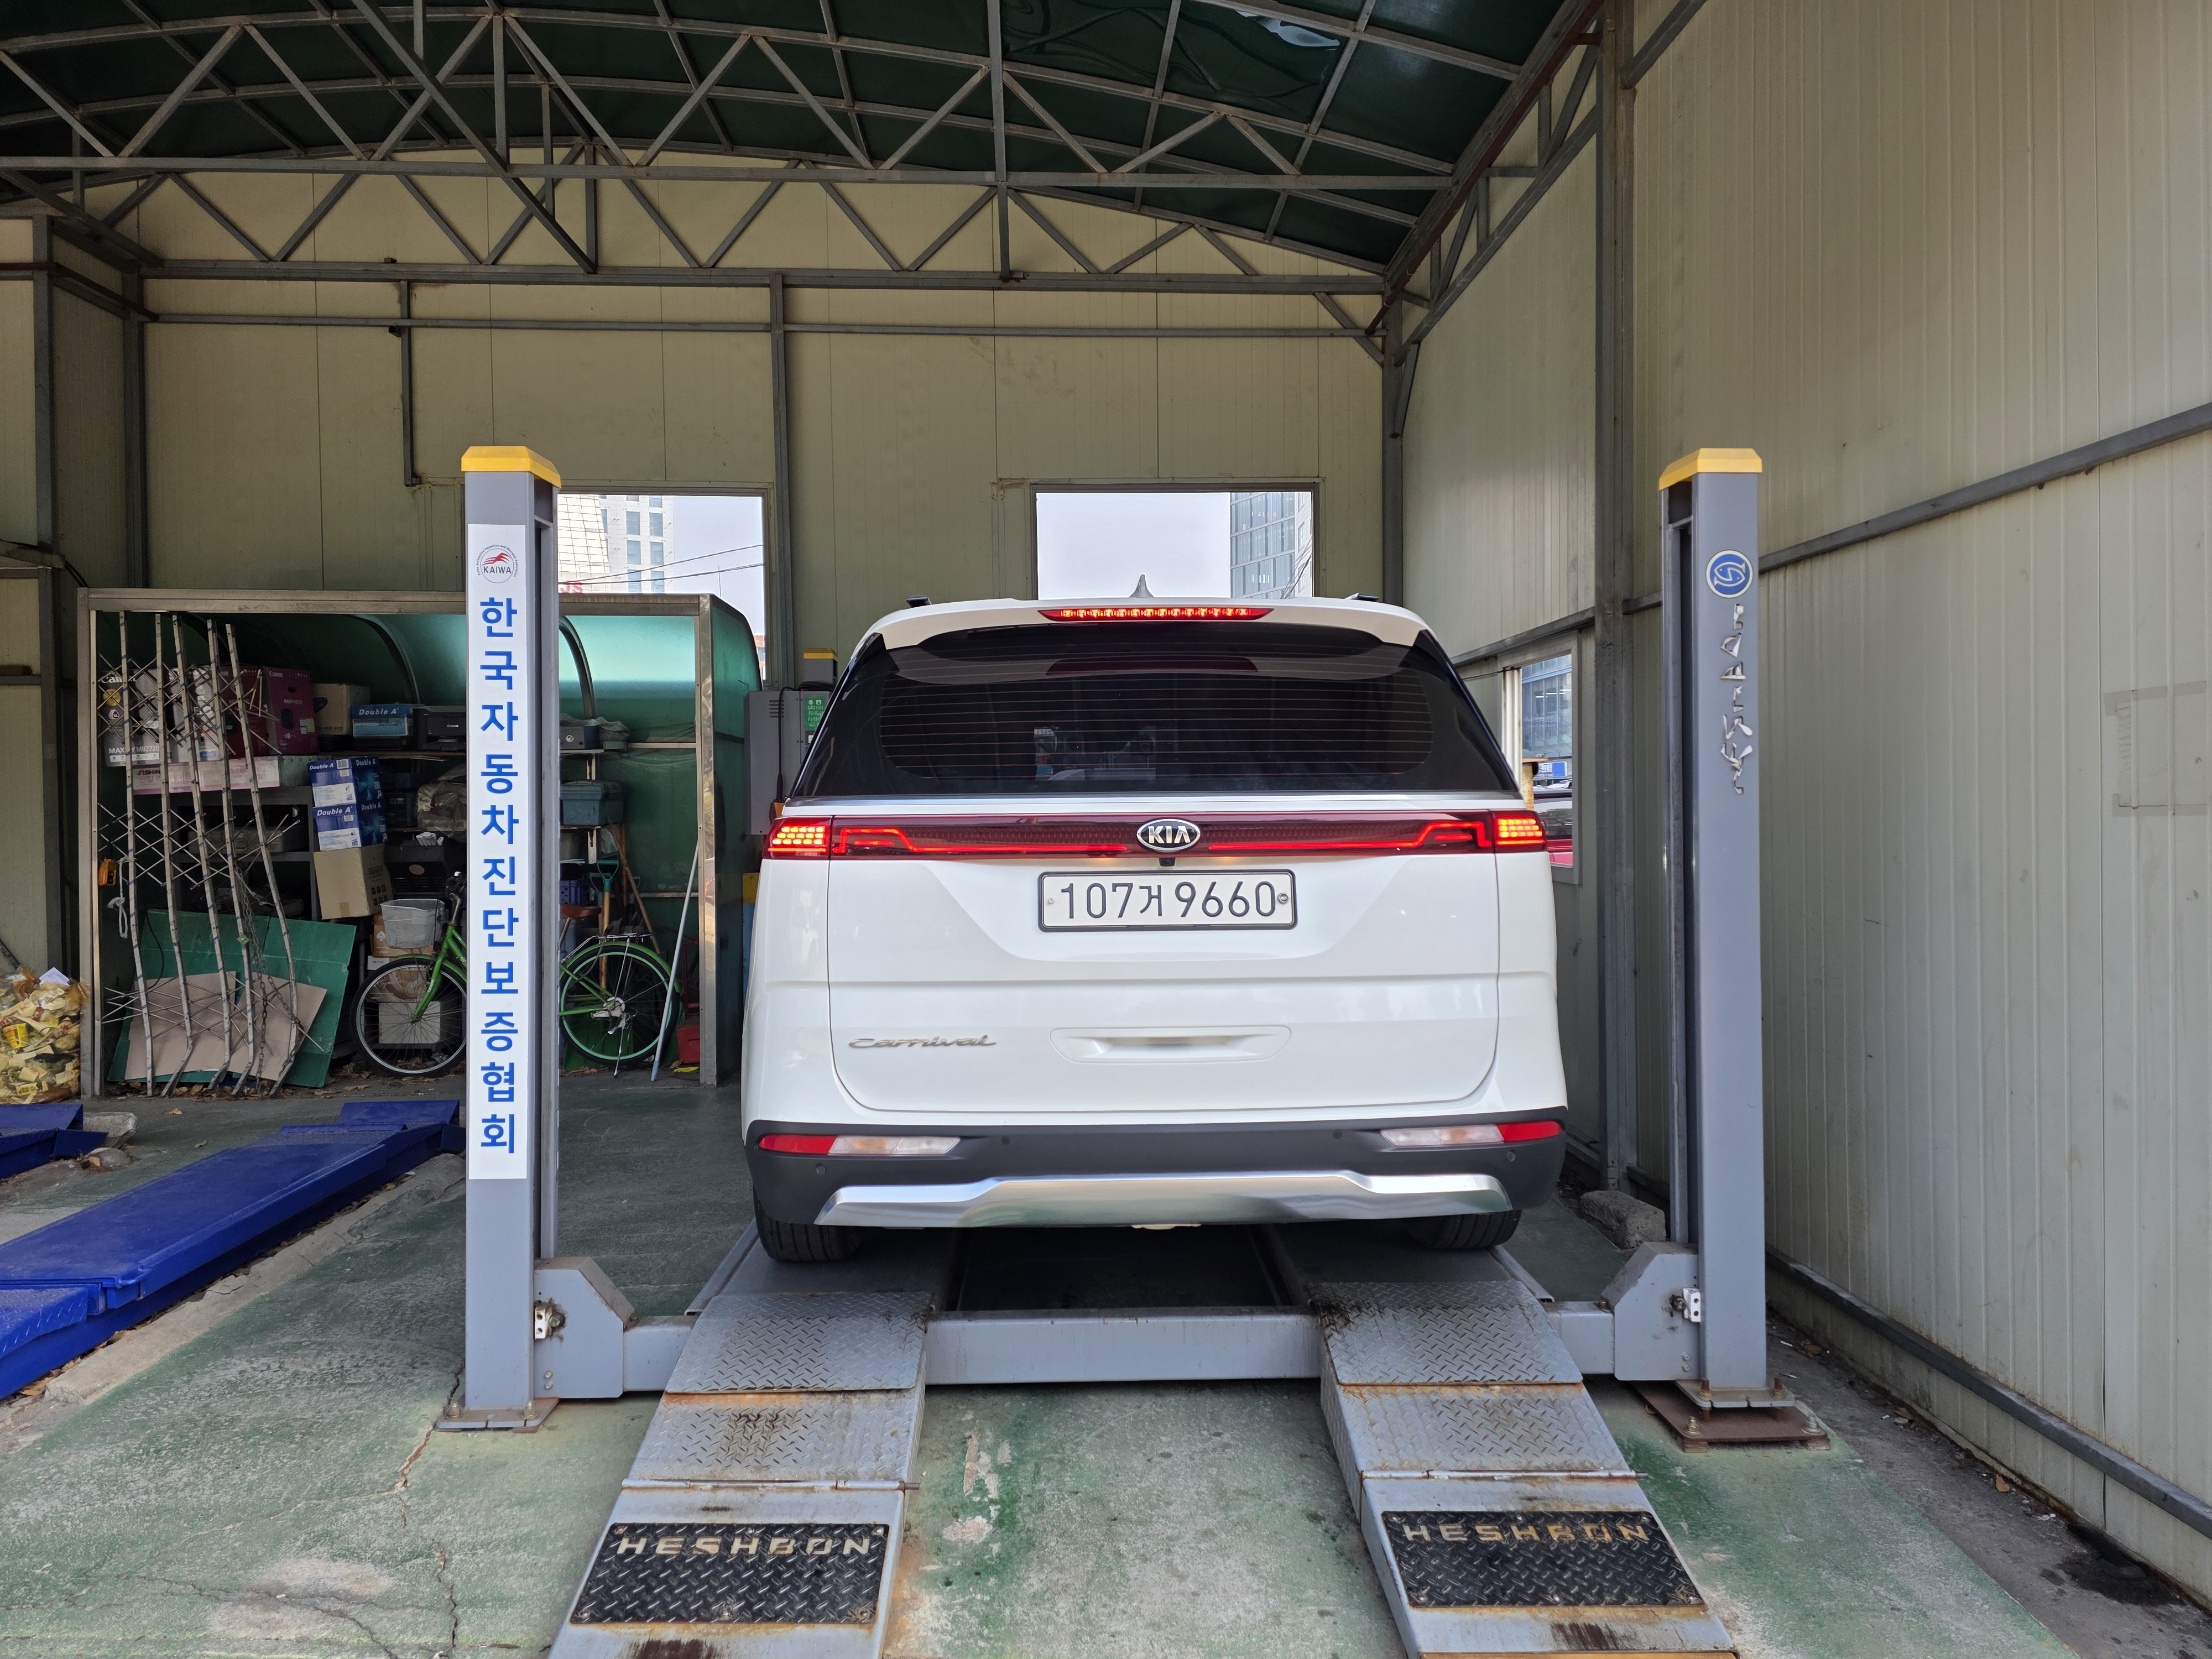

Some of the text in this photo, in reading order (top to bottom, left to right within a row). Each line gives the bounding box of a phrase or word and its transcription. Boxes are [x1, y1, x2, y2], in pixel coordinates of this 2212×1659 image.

[507, 547, 517, 559] Warranty
[483, 566, 512, 574] KAIWA
[1148, 825, 1191, 844] KIA
[479, 597, 519, 1154] 한국자동차진단보증협회
[848, 1035, 997, 1048] Carnival
[616, 1536, 870, 1556] HESHBON
